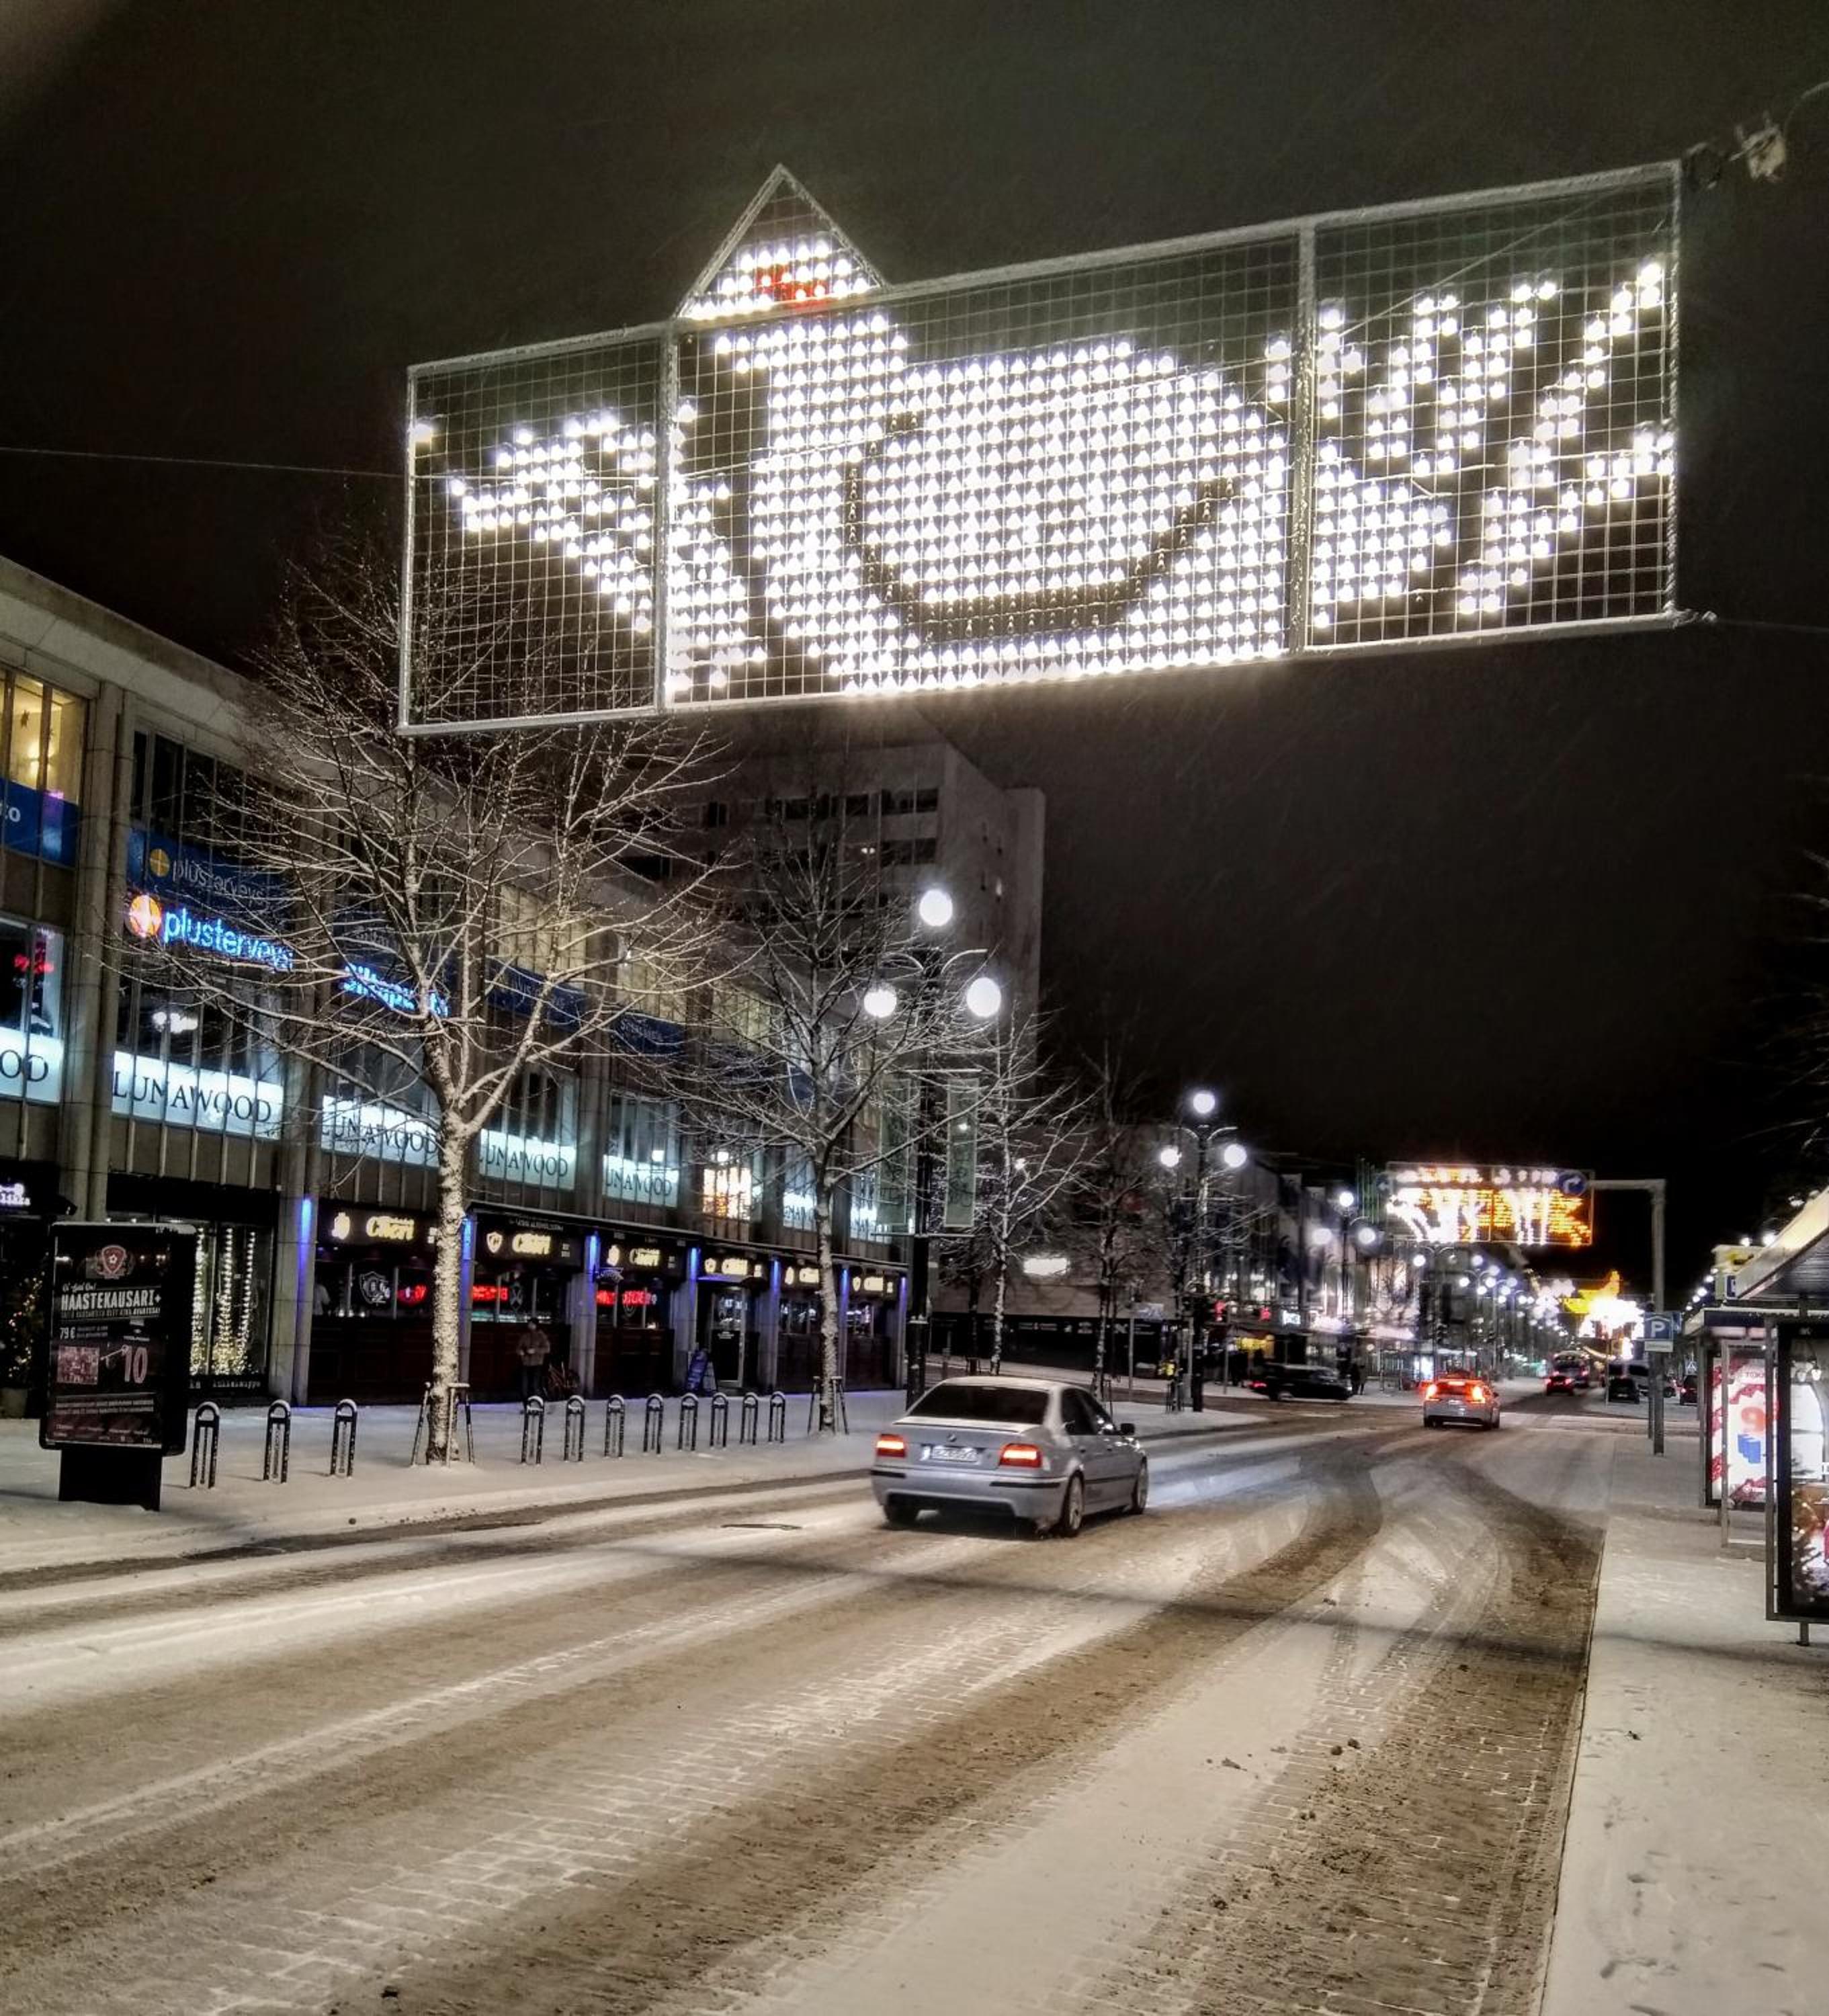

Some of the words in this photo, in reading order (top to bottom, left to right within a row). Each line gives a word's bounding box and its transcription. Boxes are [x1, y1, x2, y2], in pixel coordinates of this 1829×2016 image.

[113, 1071, 271, 1124] LUNAWOOD
[478, 1145, 569, 1178] UNAWOOD
[1651, 1321, 1666, 1337] P
